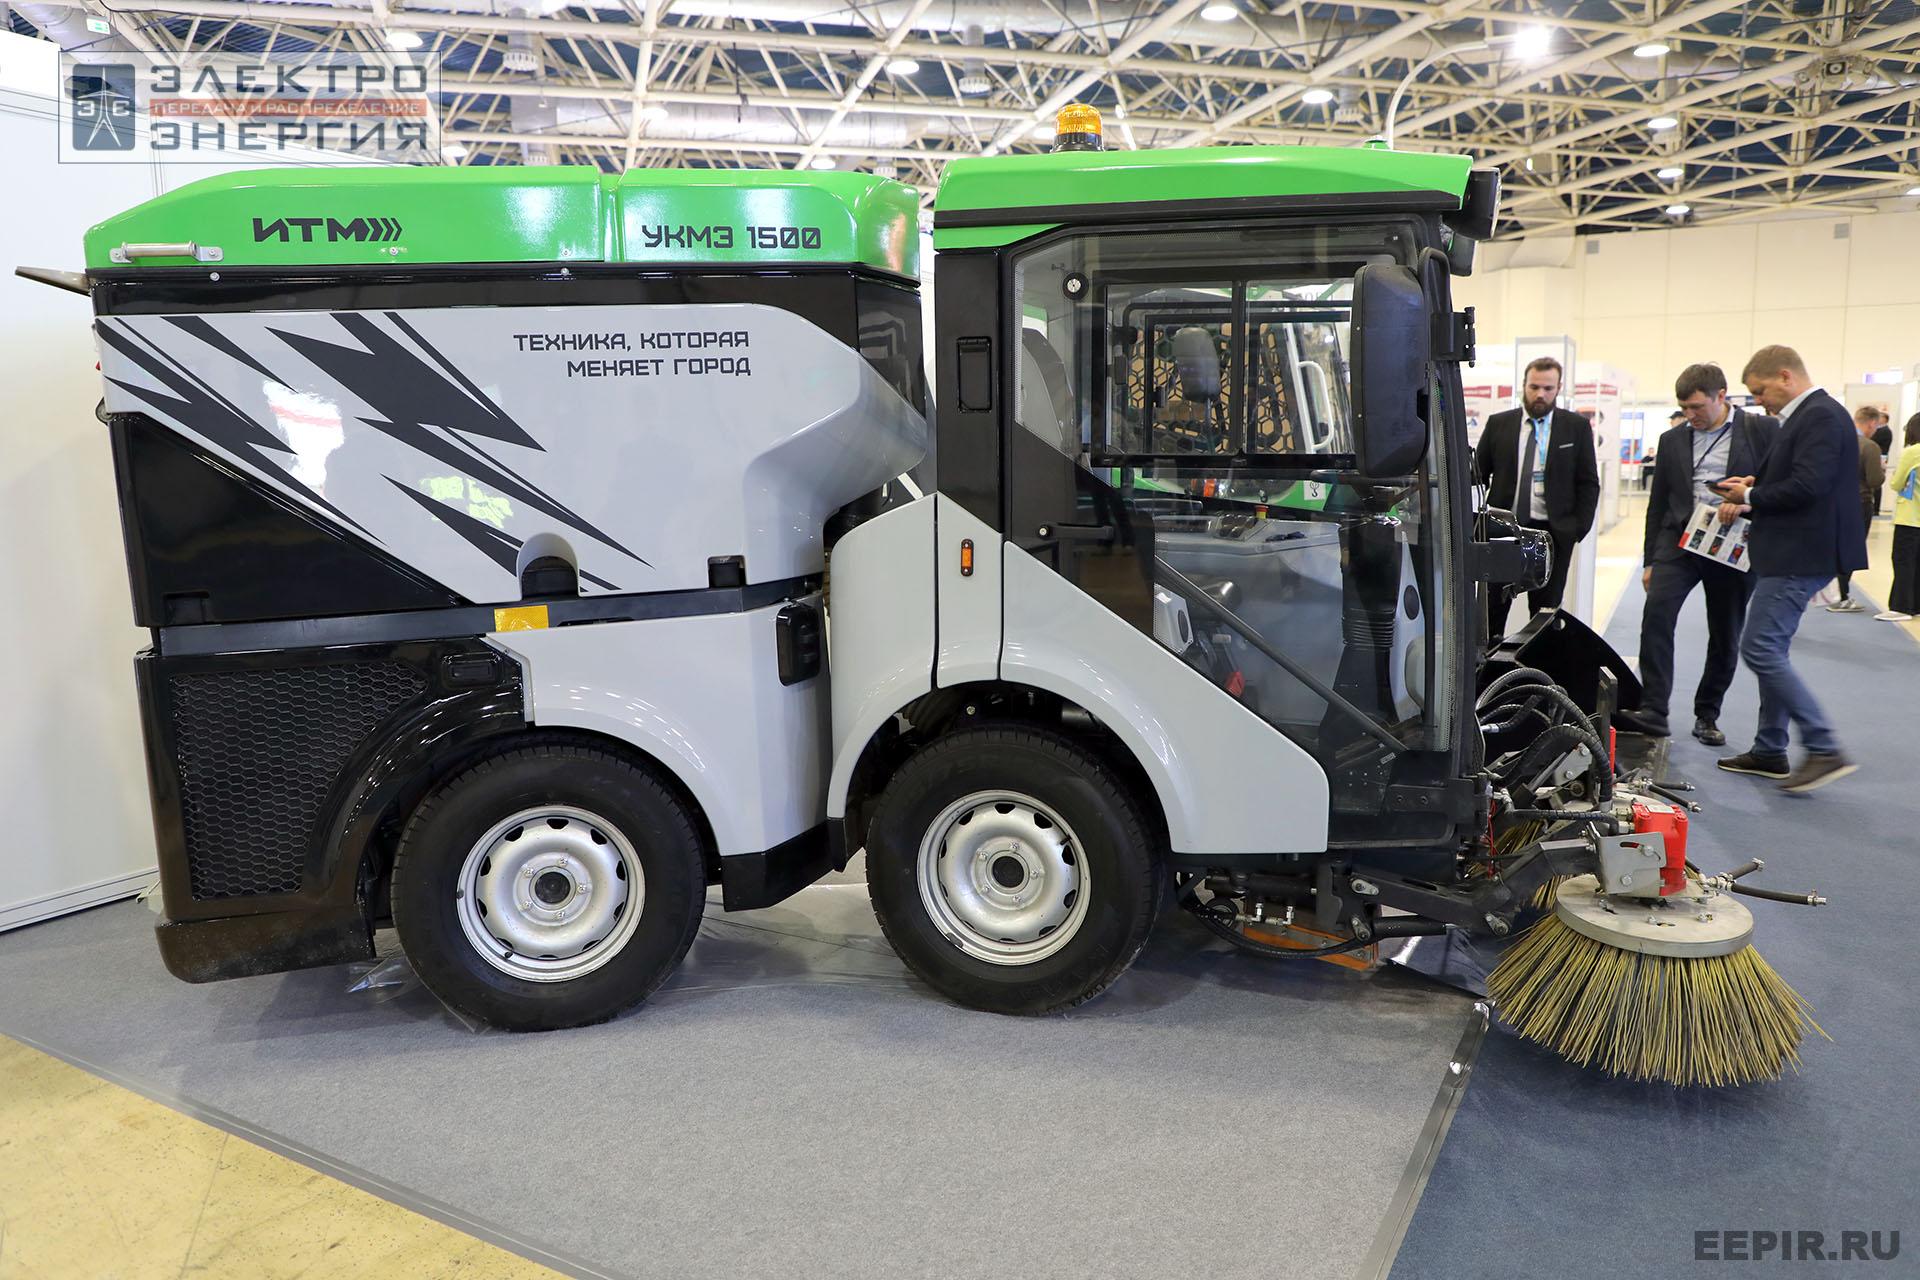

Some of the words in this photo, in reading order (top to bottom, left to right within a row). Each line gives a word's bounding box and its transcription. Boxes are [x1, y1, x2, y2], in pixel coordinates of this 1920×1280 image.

[253, 218, 370, 242] ИТМ
[746, 226, 821, 249] 1500
[513, 333, 631, 352] ТЕХНИКА,
[640, 331, 749, 349] КОТОРАЯ
[567, 359, 664, 377] МЕНЯЕТ
[674, 357, 751, 376] ГОРОД
